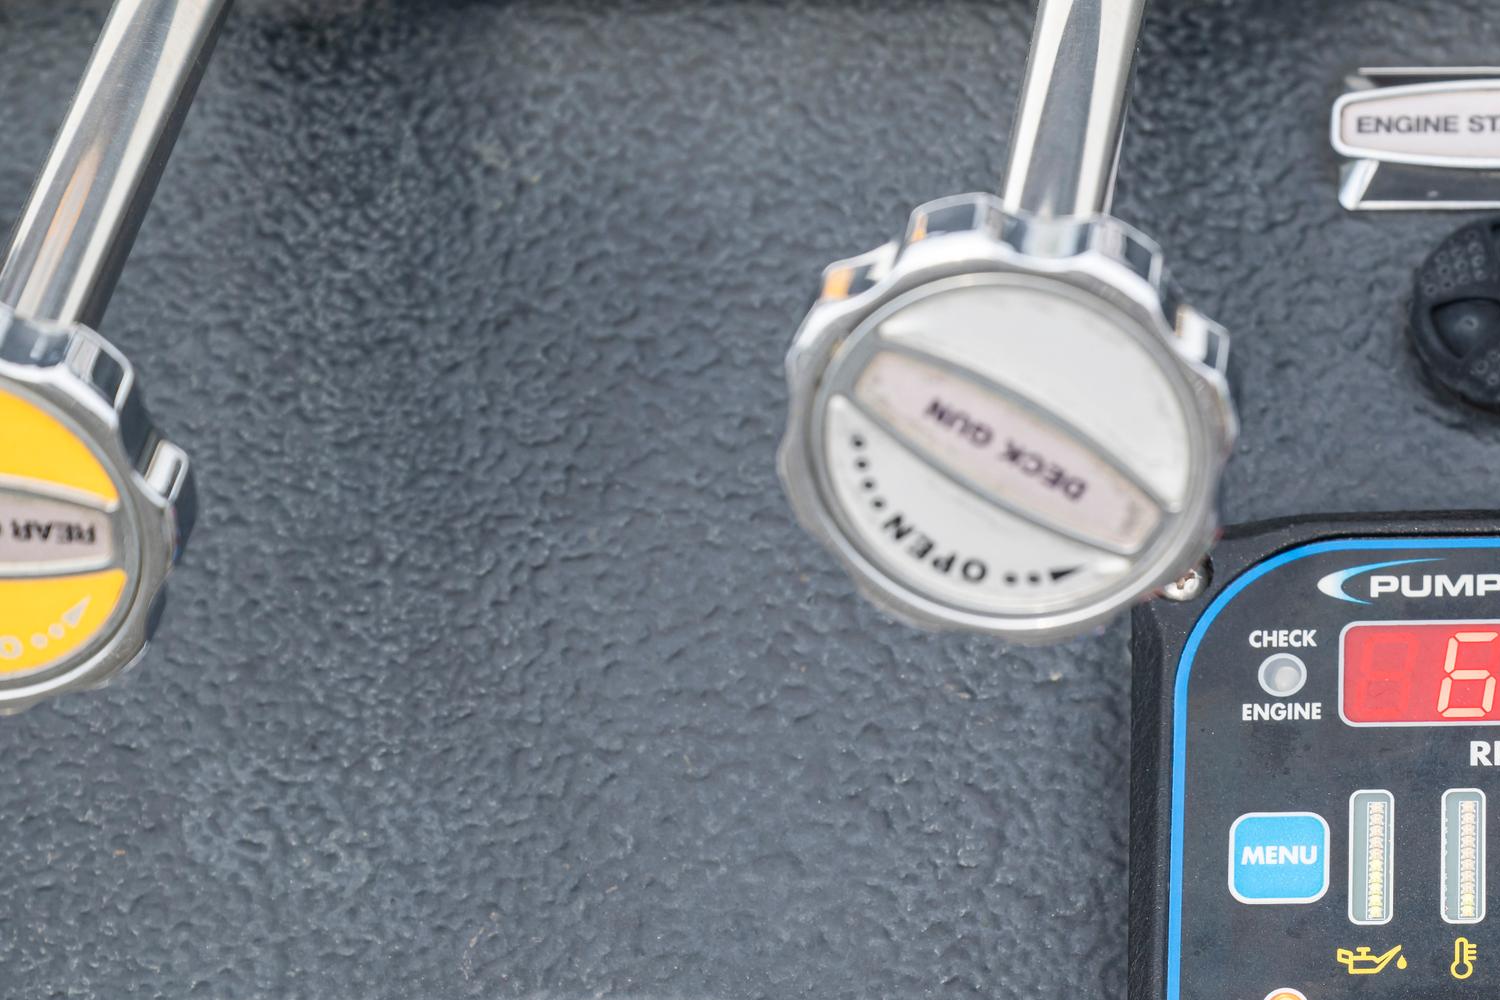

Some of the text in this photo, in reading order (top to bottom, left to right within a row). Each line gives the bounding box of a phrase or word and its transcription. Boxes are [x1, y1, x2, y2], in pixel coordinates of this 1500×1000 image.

[1356, 115, 1460, 134] ENGINE
[922, 399, 1087, 502] DECK GUN
[11, 519, 96, 544] REAR
[883, 513, 989, 584] OPEN
[1248, 629, 1317, 649] CHECK
[1241, 702, 1322, 722] ENGINE
[1241, 845, 1318, 866] MENU
